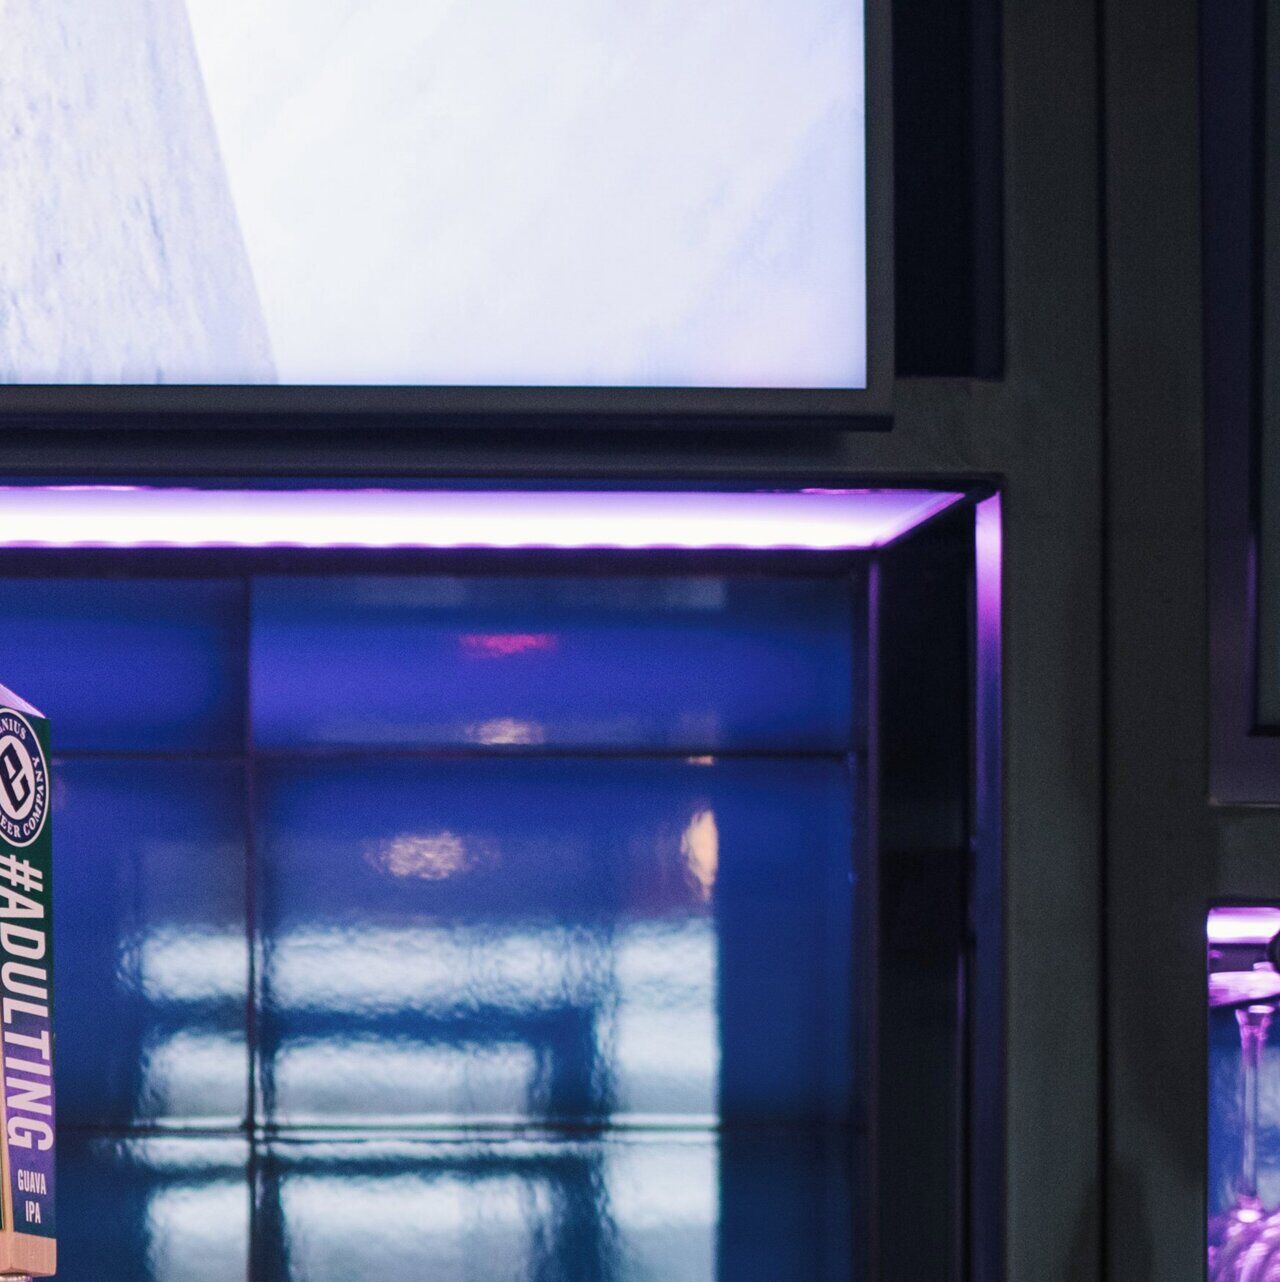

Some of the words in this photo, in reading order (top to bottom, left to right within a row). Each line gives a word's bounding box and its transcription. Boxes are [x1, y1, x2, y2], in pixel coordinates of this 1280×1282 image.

[23, 756, 45, 836] COMPANY
[17, 1168, 47, 1196] GUAVA
[25, 1199, 41, 1225] IPA
